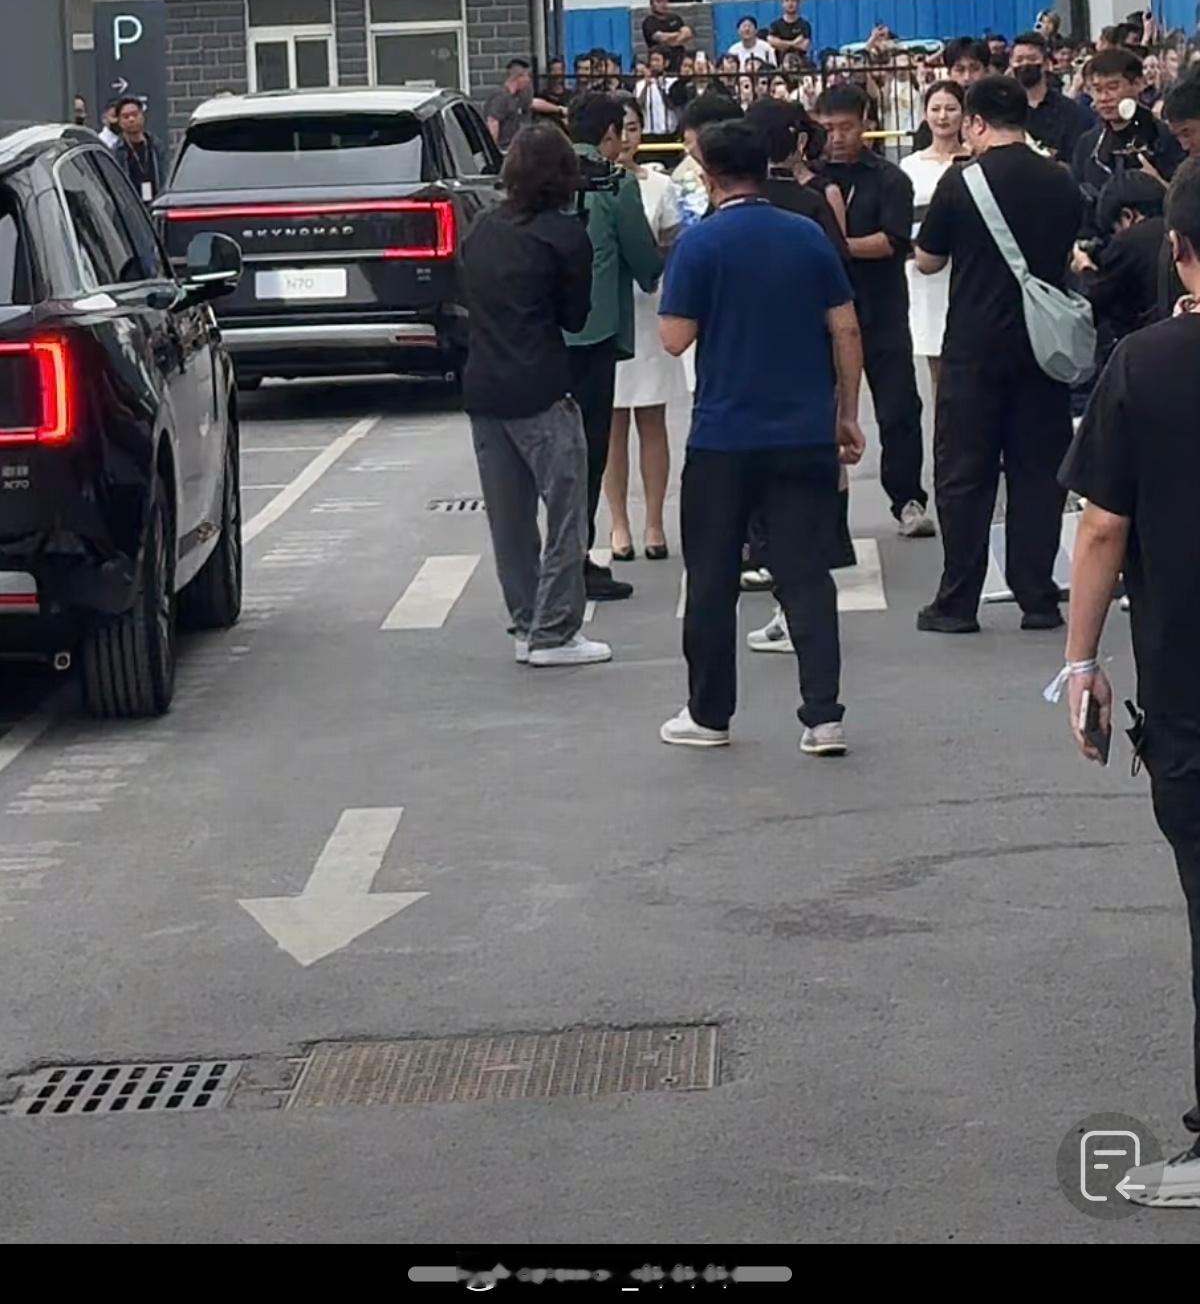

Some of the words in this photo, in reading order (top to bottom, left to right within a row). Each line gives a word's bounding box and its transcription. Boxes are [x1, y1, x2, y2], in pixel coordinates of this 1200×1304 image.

[114, 15, 142, 60] P
[242, 226, 354, 238] SKYNOMAD
[286, 278, 315, 290] N70
